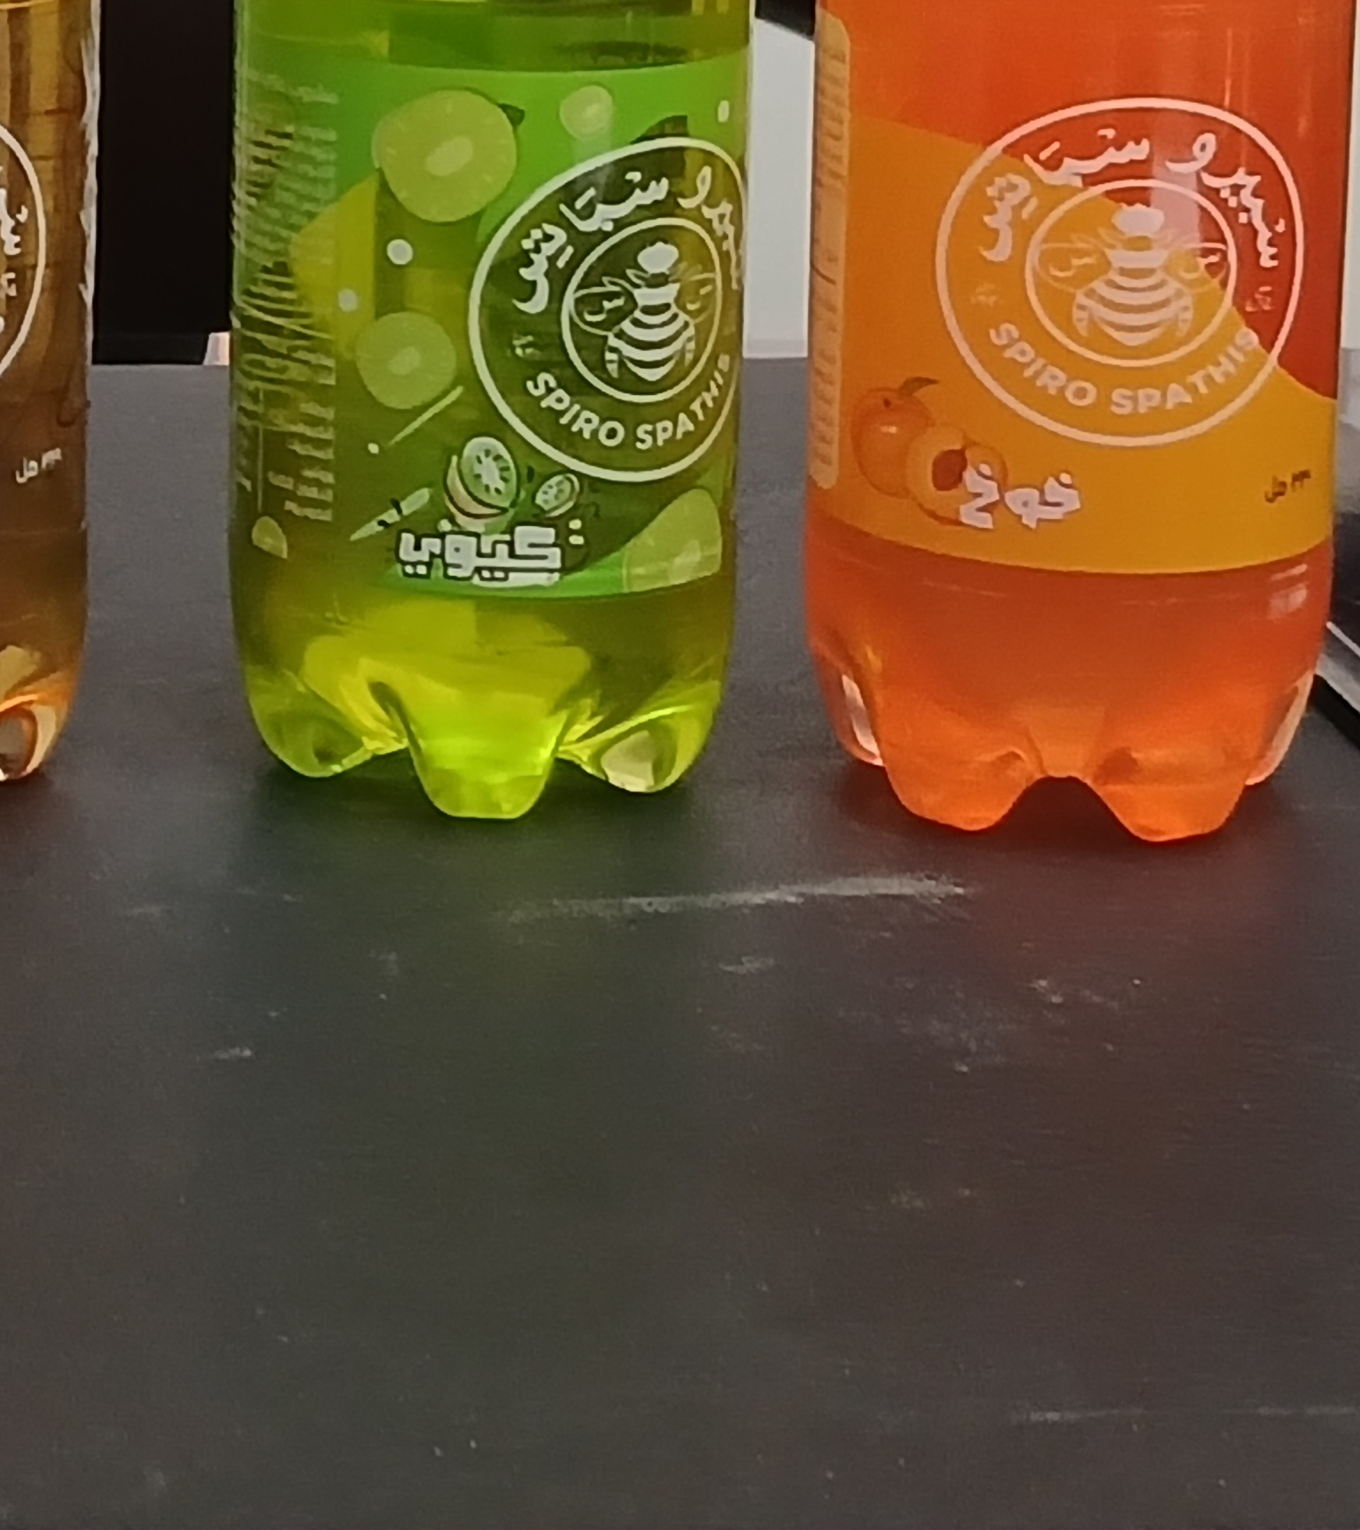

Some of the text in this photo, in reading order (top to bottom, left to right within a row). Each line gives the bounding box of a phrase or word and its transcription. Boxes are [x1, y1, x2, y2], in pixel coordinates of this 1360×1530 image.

[989, 322, 1260, 415] SPIRO SPATHIS
[526, 372, 625, 447] SPIRO
[960, 463, 1082, 530] خوخ
[399, 520, 564, 580] كيوي
